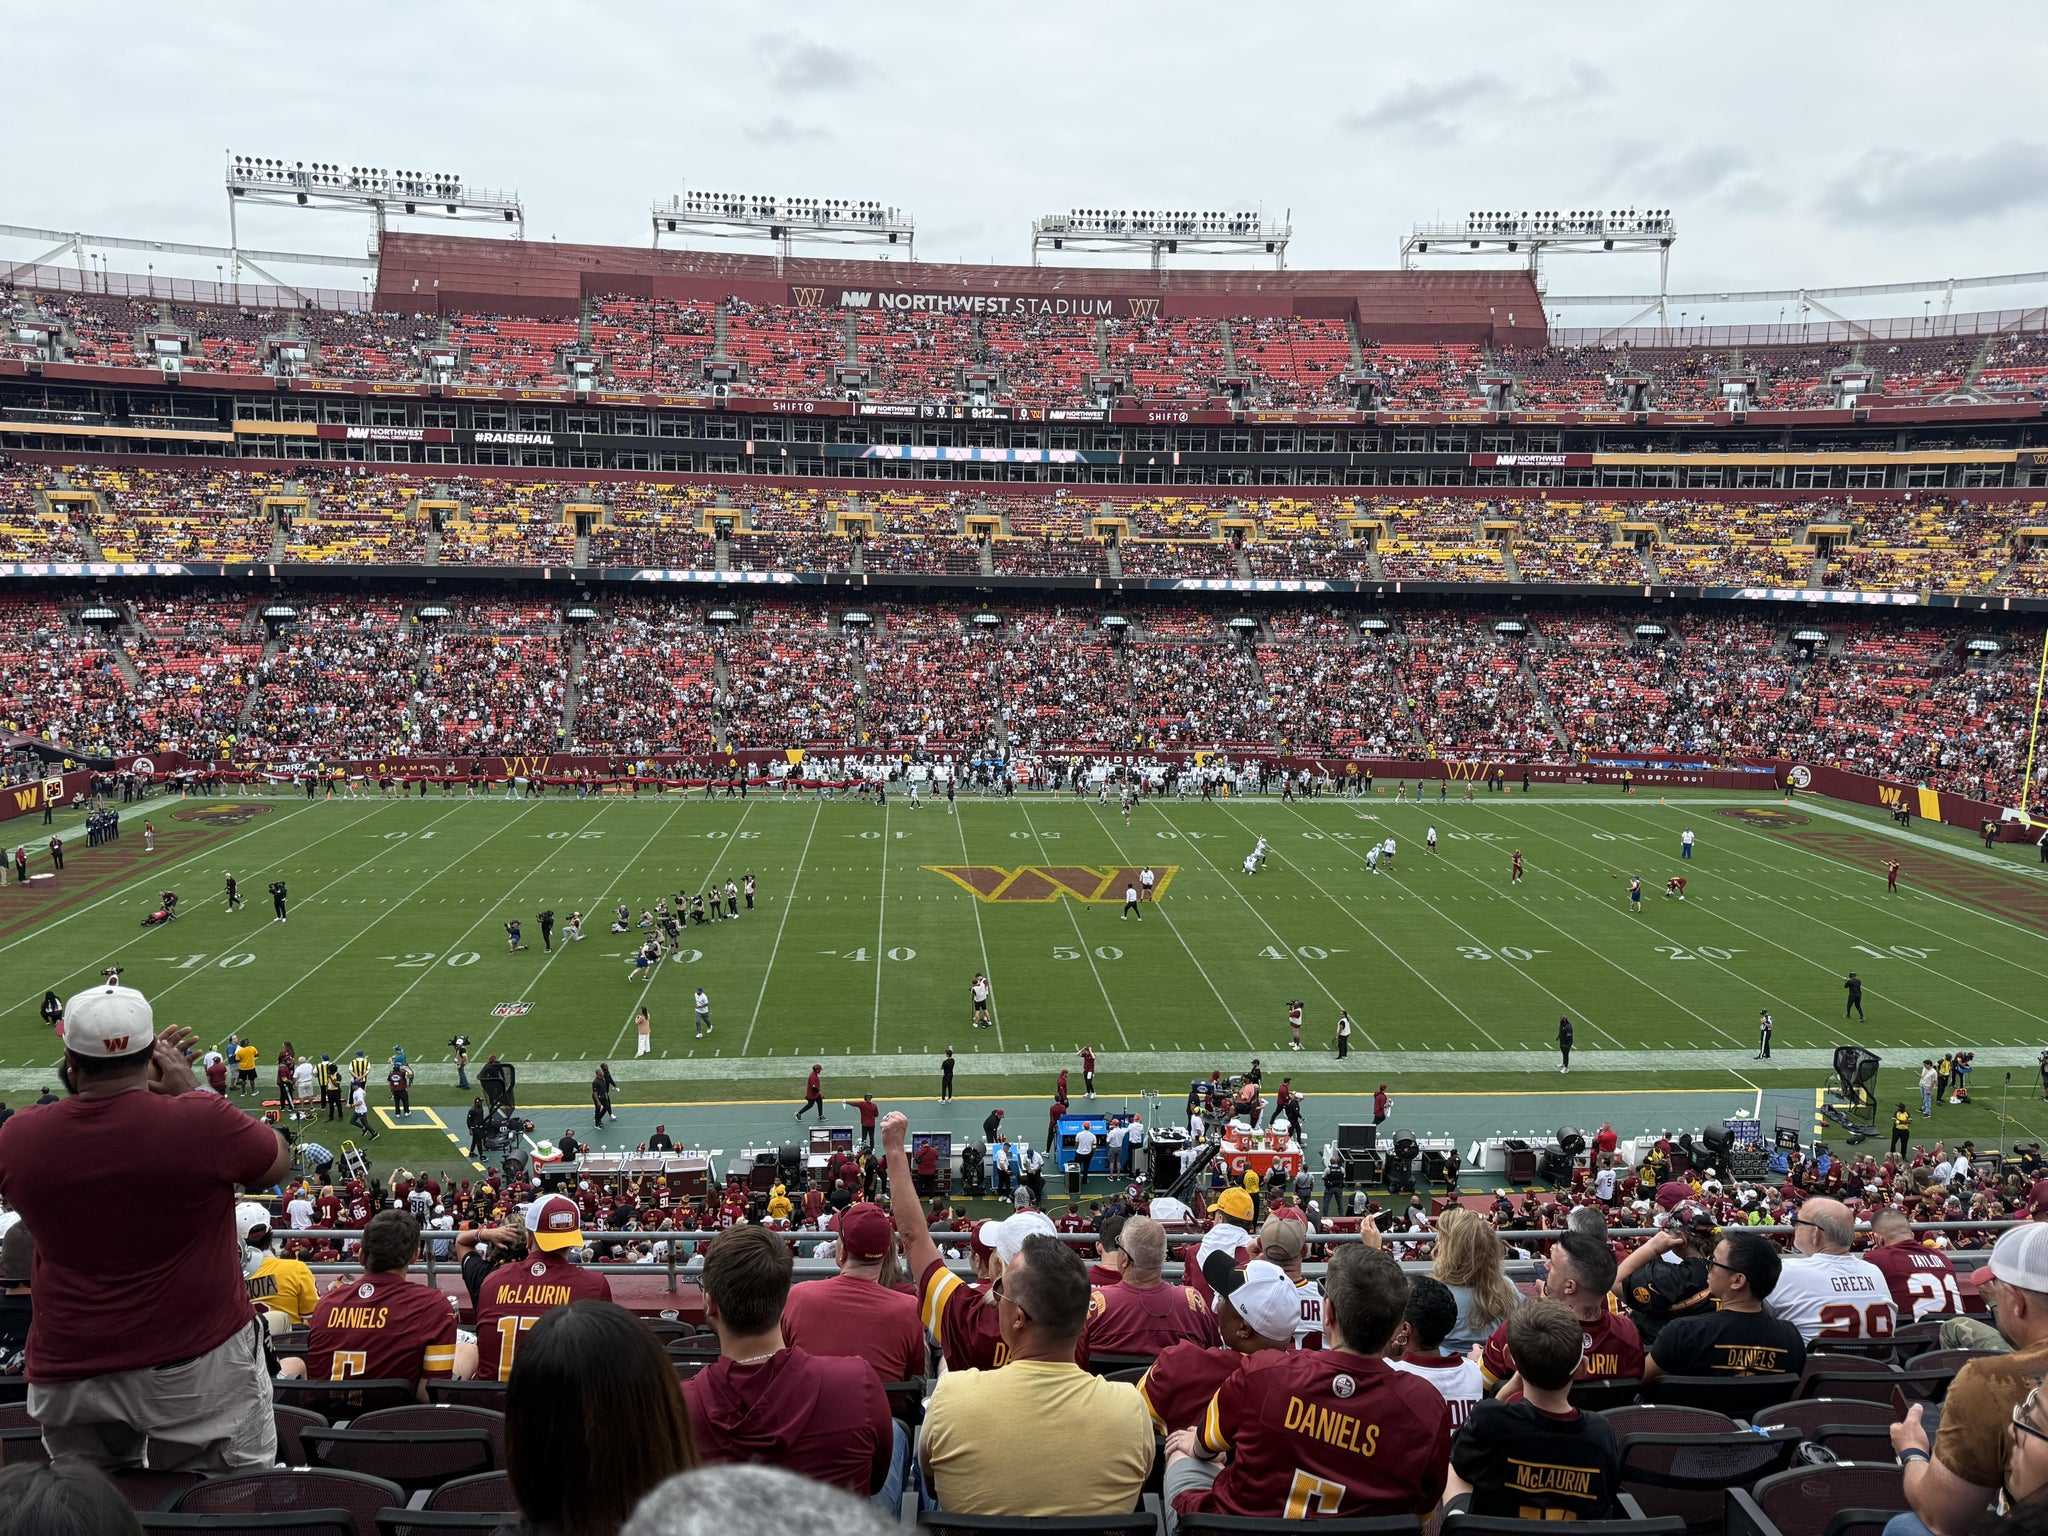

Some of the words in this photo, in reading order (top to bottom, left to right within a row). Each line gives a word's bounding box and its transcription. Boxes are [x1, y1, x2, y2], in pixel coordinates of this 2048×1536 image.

[879, 292, 1010, 313] NORTHWEST
[1016, 298, 1112, 316] STADIUM
[938, 407, 945, 415] 0
[972, 408, 992, 418] 9:12
[1021, 409, 1027, 417] 0
[370, 428, 424, 436] NORTHWEST
[474, 432, 554, 444] #RAISEHAIL
[48, 782, 60, 796] 25
[842, 947, 916, 962] 40
[1052, 946, 1124, 960] 50
[1258, 946, 1328, 960] 40
[1456, 946, 1534, 961] 30
[1654, 946, 1733, 960] 20
[1850, 945, 1928, 959] 10
[170, 953, 256, 969] 10
[394, 952, 481, 967] 20
[1232, 1156, 1247, 1172] G
[1606, 1178, 1612, 1187] 5
[660, 1197, 670, 1208] 91
[1882, 1192, 1890, 1202] 5
[322, 1205, 331, 1219] 11
[353, 1208, 367, 1220] 86
[411, 1201, 424, 1213] 98
[722, 1216, 733, 1228] 21
[1908, 1254, 1946, 1268] TAYLOR
[1830, 1276, 1875, 1292] GREEN
[496, 1284, 571, 1305] McLAURIN
[1906, 1273, 1964, 1324] 21
[327, 1307, 388, 1329] DANIELS
[1728, 1348, 1776, 1369] DANIELS
[1284, 1396, 1380, 1457] DANIELS
[1517, 1464, 1590, 1494] McLAURIN
